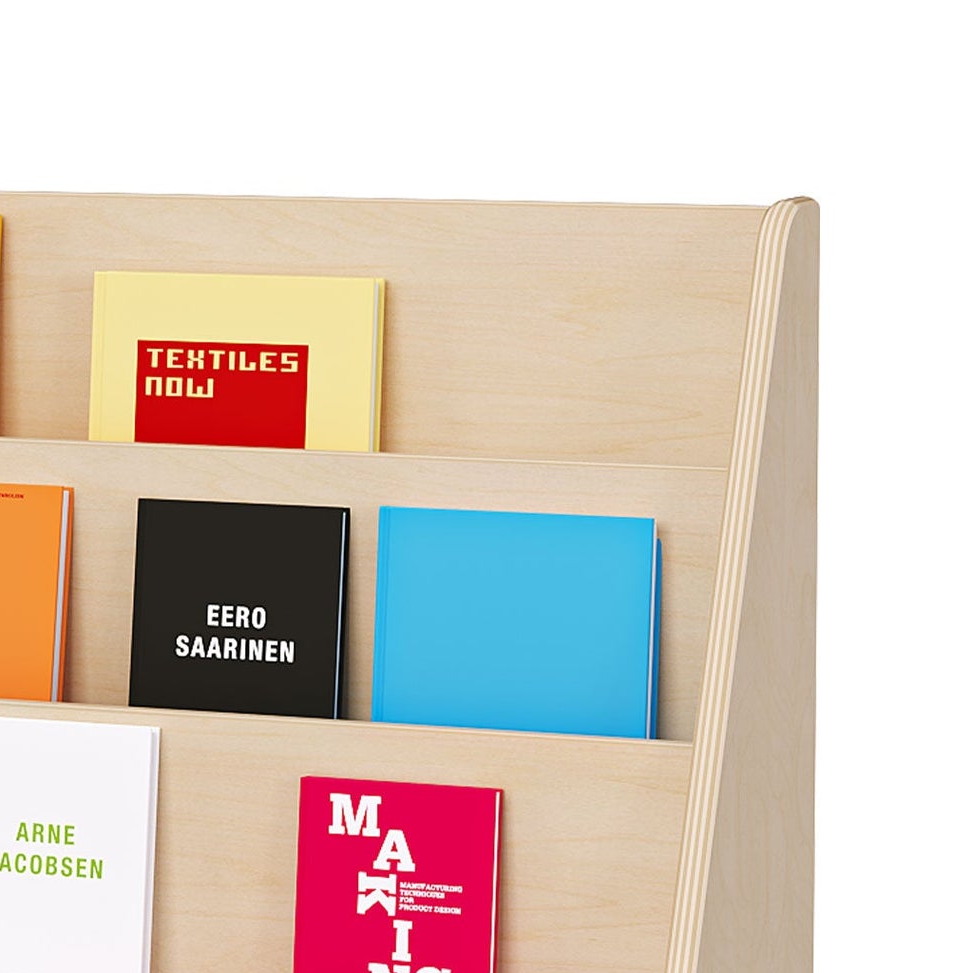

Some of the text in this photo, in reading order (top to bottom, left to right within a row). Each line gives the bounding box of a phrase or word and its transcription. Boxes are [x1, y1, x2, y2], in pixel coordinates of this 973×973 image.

[147, 349, 298, 372] TEXTILES
[207, 604, 266, 629] EERO
[176, 635, 294, 663] SAARINEN
[16, 822, 75, 845] ARNE
[400, 882, 463, 893] MANUFACTURING
